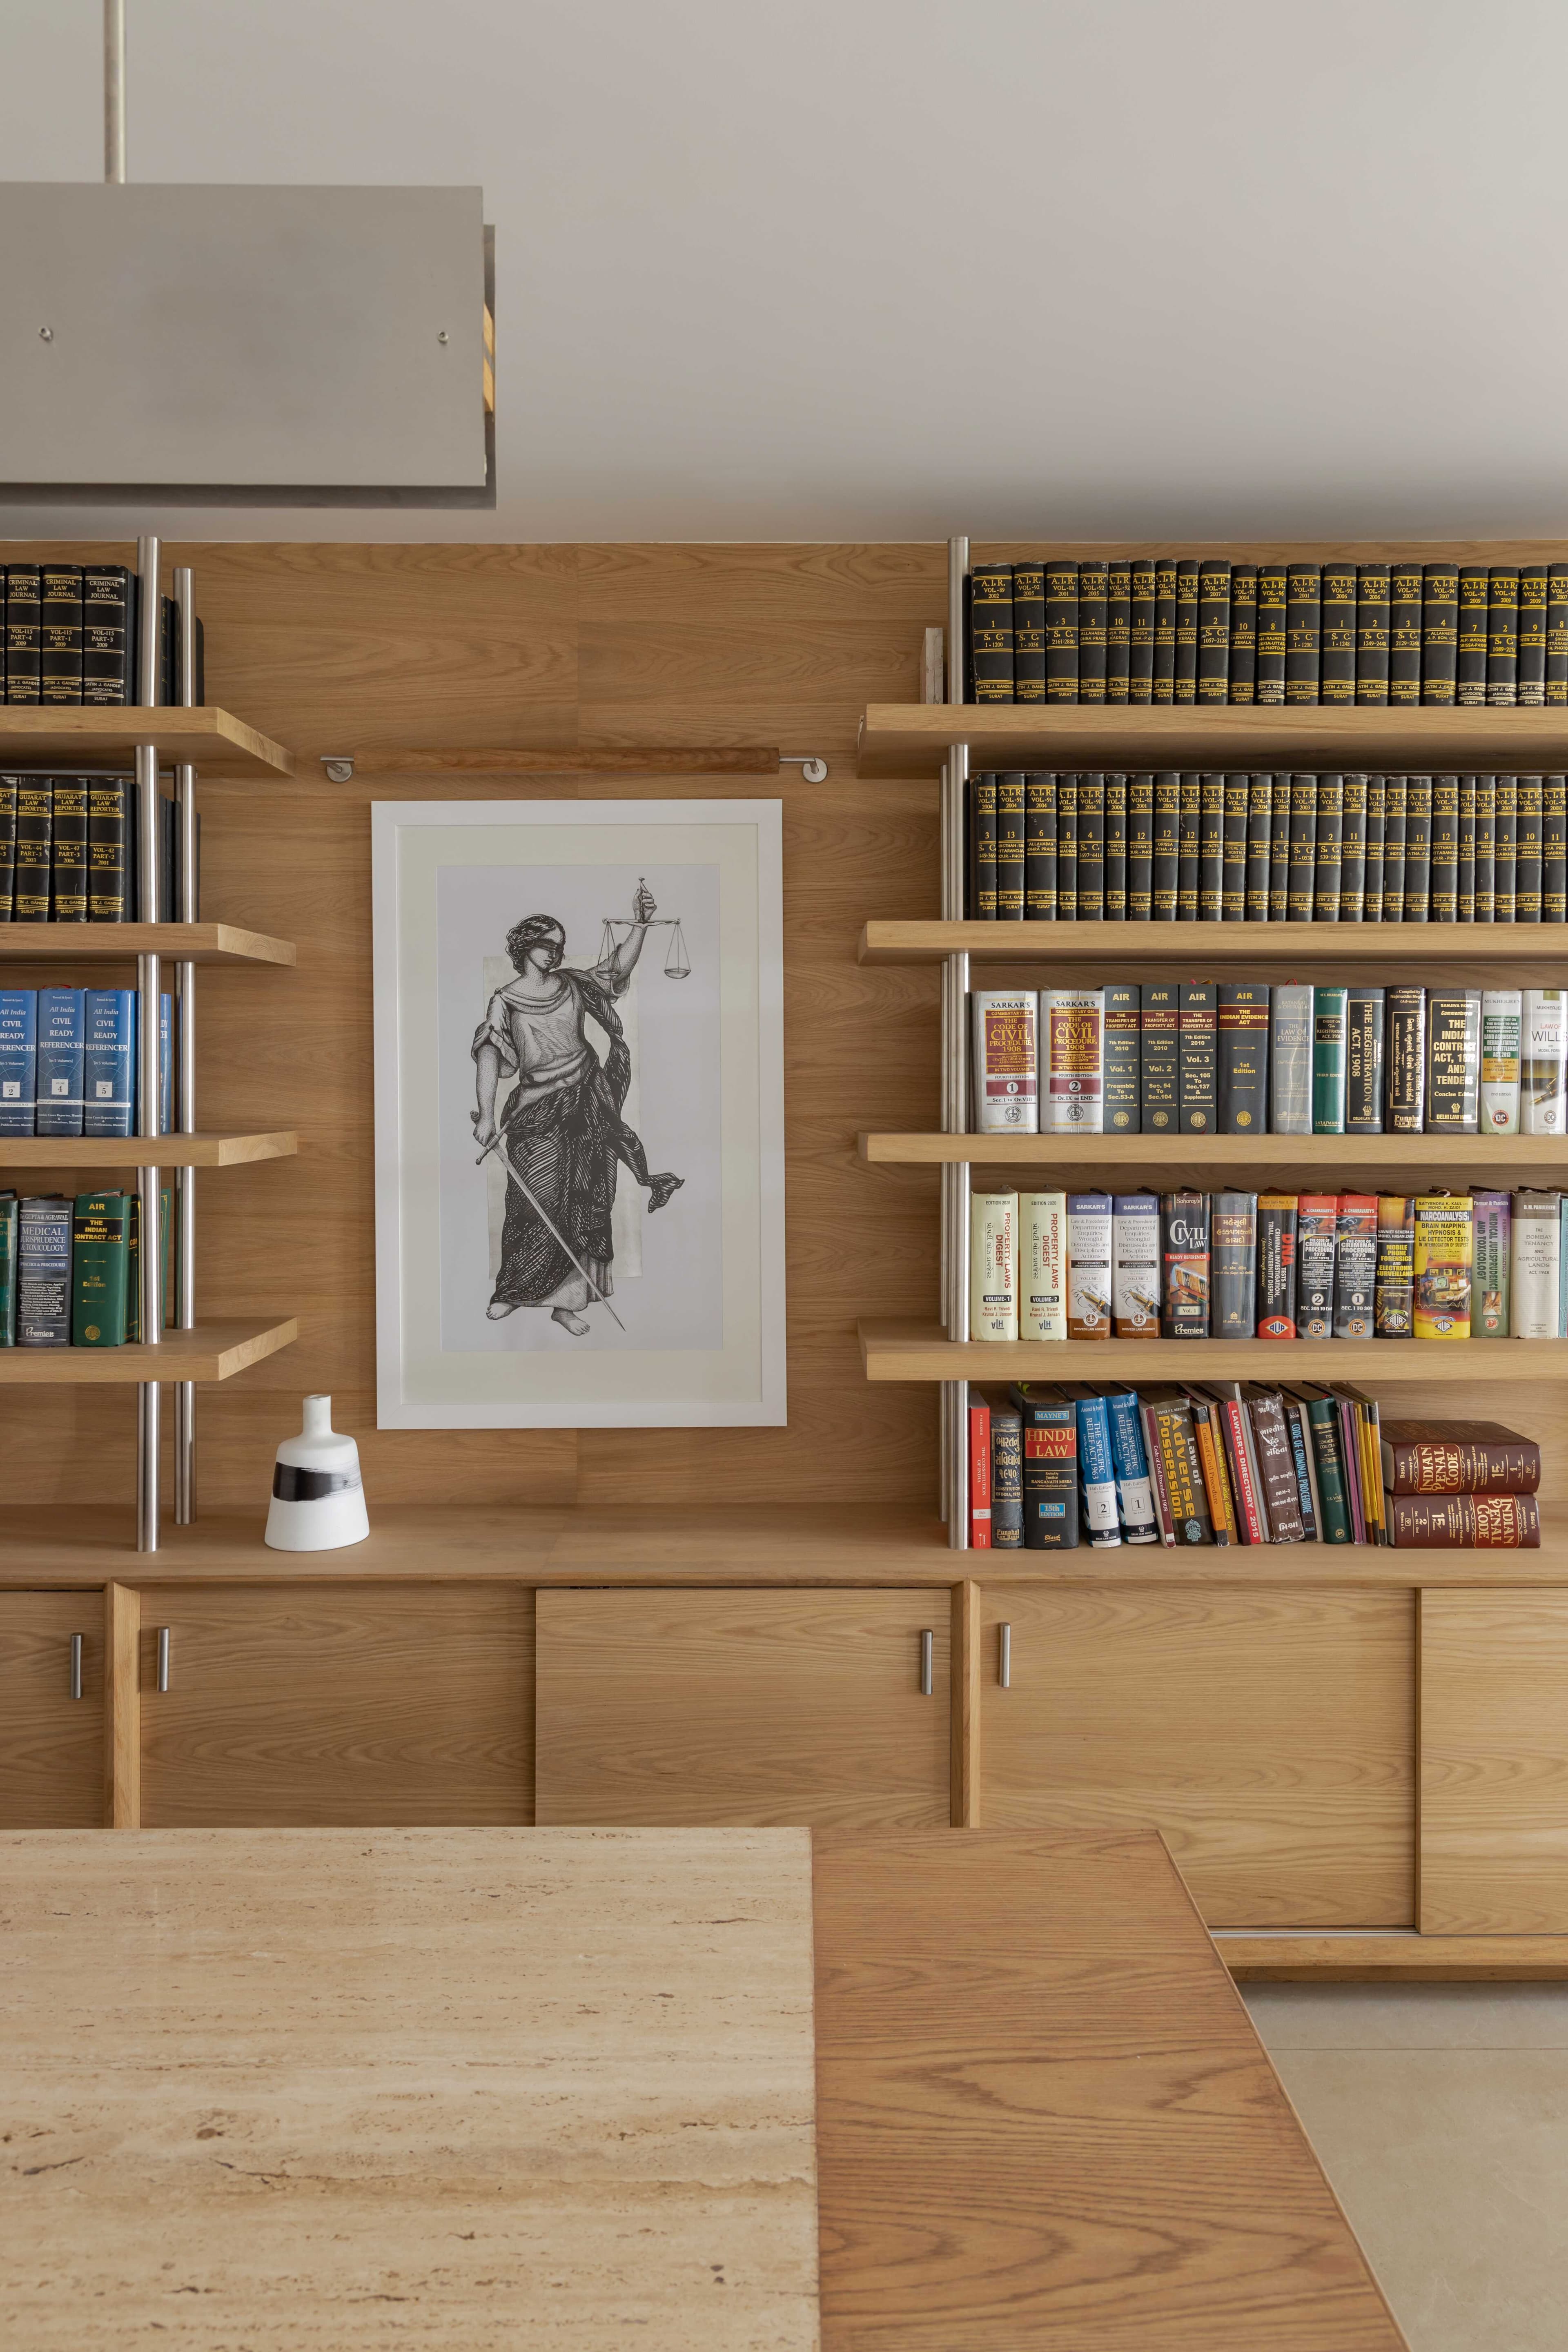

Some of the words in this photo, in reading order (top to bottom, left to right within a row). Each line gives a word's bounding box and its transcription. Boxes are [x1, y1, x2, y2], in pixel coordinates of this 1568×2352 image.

[1364, 1003, 1372, 1023] THE
[1056, 1028, 1096, 1038] CIVIL
[1352, 1028, 1361, 1049] ACT,
[1364, 1028, 1372, 1102] REGISTRATION
[1071, 1082, 1078, 1090] 2
[22, 1227, 63, 1235] MEDICAL
[1420, 1212, 1469, 1221] NARCOANALYSIS,
[1282, 1234, 1294, 1266] DNA
[1027, 1430, 1075, 1441] HINDU
[1036, 1445, 1067, 1457] LAW
[1128, 1436, 1138, 1470] SPECIFIC
[1170, 1414, 1195, 1516] Adverse
[1187, 1437, 1197, 1466] Law
[1193, 1470, 1202, 1486] of
[1419, 1447, 1433, 1491] INDIAN
[1432, 1447, 1446, 1491] PENAL
[1232, 1410, 1244, 1455] LAWYER'S
[1240, 1458, 1254, 1508] DIRECTORY
[1250, 1517, 1259, 1537] 2015
[1446, 1453, 1458, 1486] CODE
